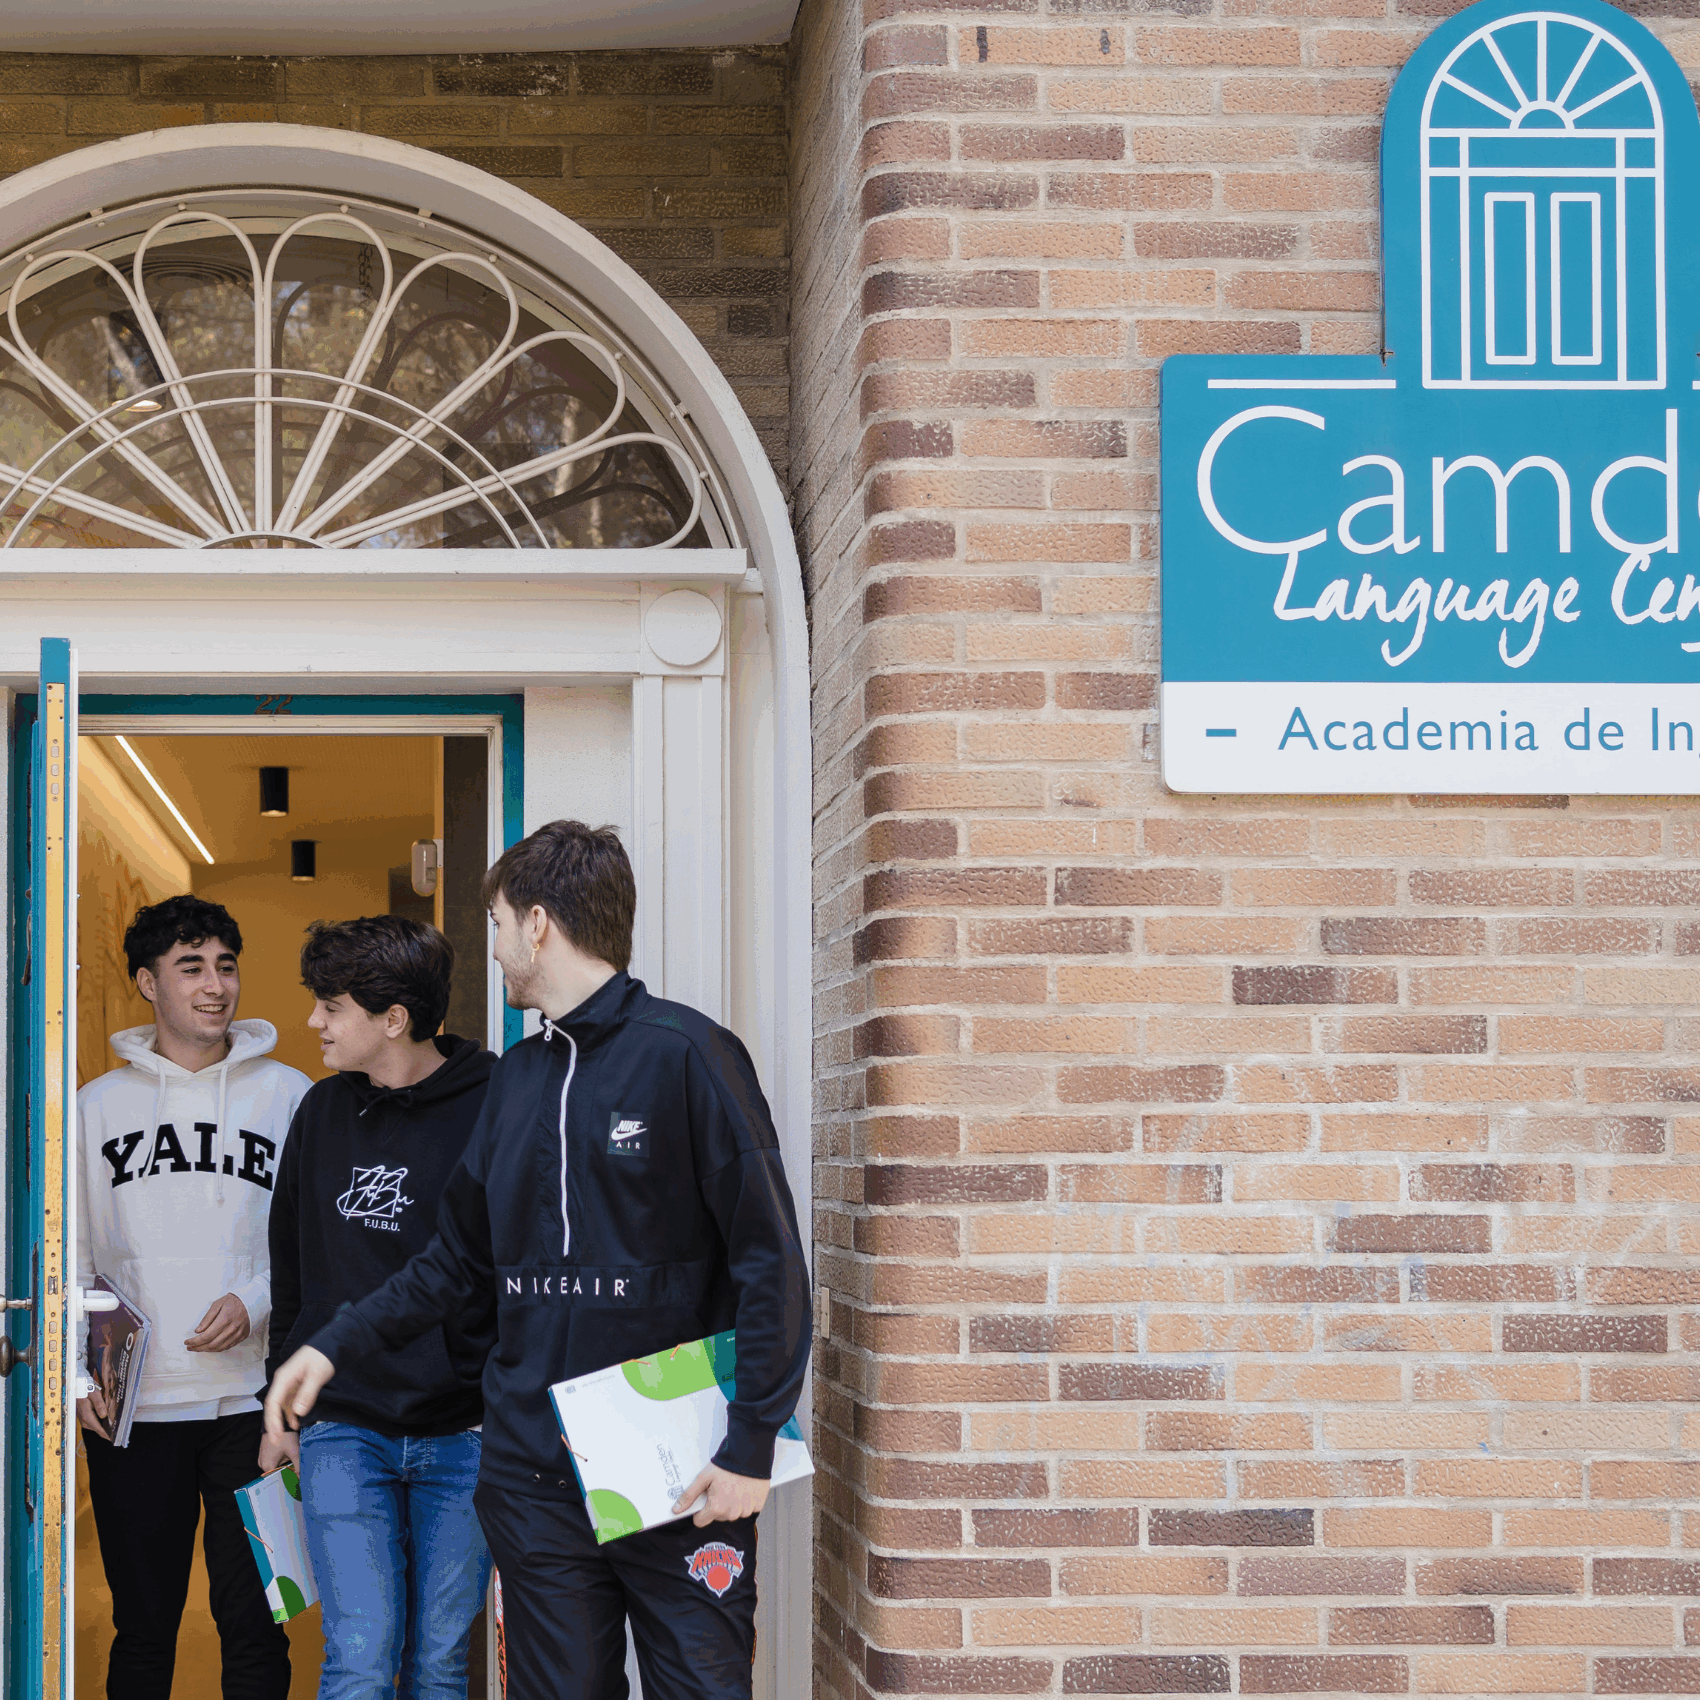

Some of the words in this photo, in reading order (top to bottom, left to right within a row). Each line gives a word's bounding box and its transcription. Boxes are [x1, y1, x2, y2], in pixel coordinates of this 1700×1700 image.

[1197, 404, 1700, 555] Camd
[1273, 551, 1581, 668] Language
[254, 693, 293, 715] 22
[1277, 706, 1539, 751] Academia
[1563, 707, 1625, 751] de
[1651, 707, 1700, 752] In
[101, 1122, 277, 1191] YALE
[616, 1141, 641, 1150] AIR
[364, 1218, 401, 1232] F.U.B.U.
